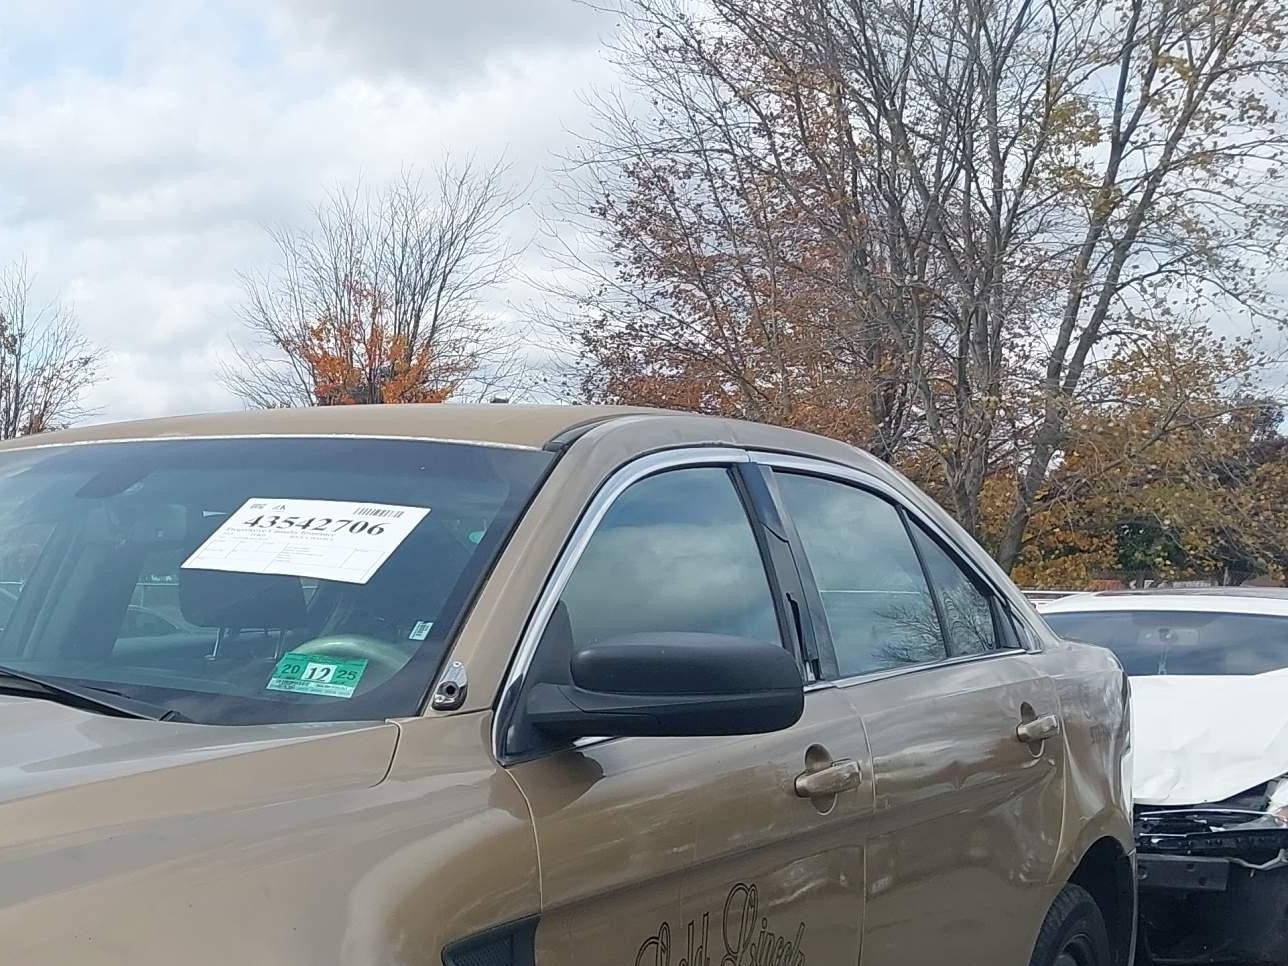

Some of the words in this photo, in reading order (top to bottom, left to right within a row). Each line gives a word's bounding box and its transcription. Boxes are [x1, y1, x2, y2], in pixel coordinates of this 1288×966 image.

[244, 514, 392, 536] 43542706
[281, 663, 301, 675] 20
[305, 666, 331, 682] 12
[336, 670, 358, 681] 25
